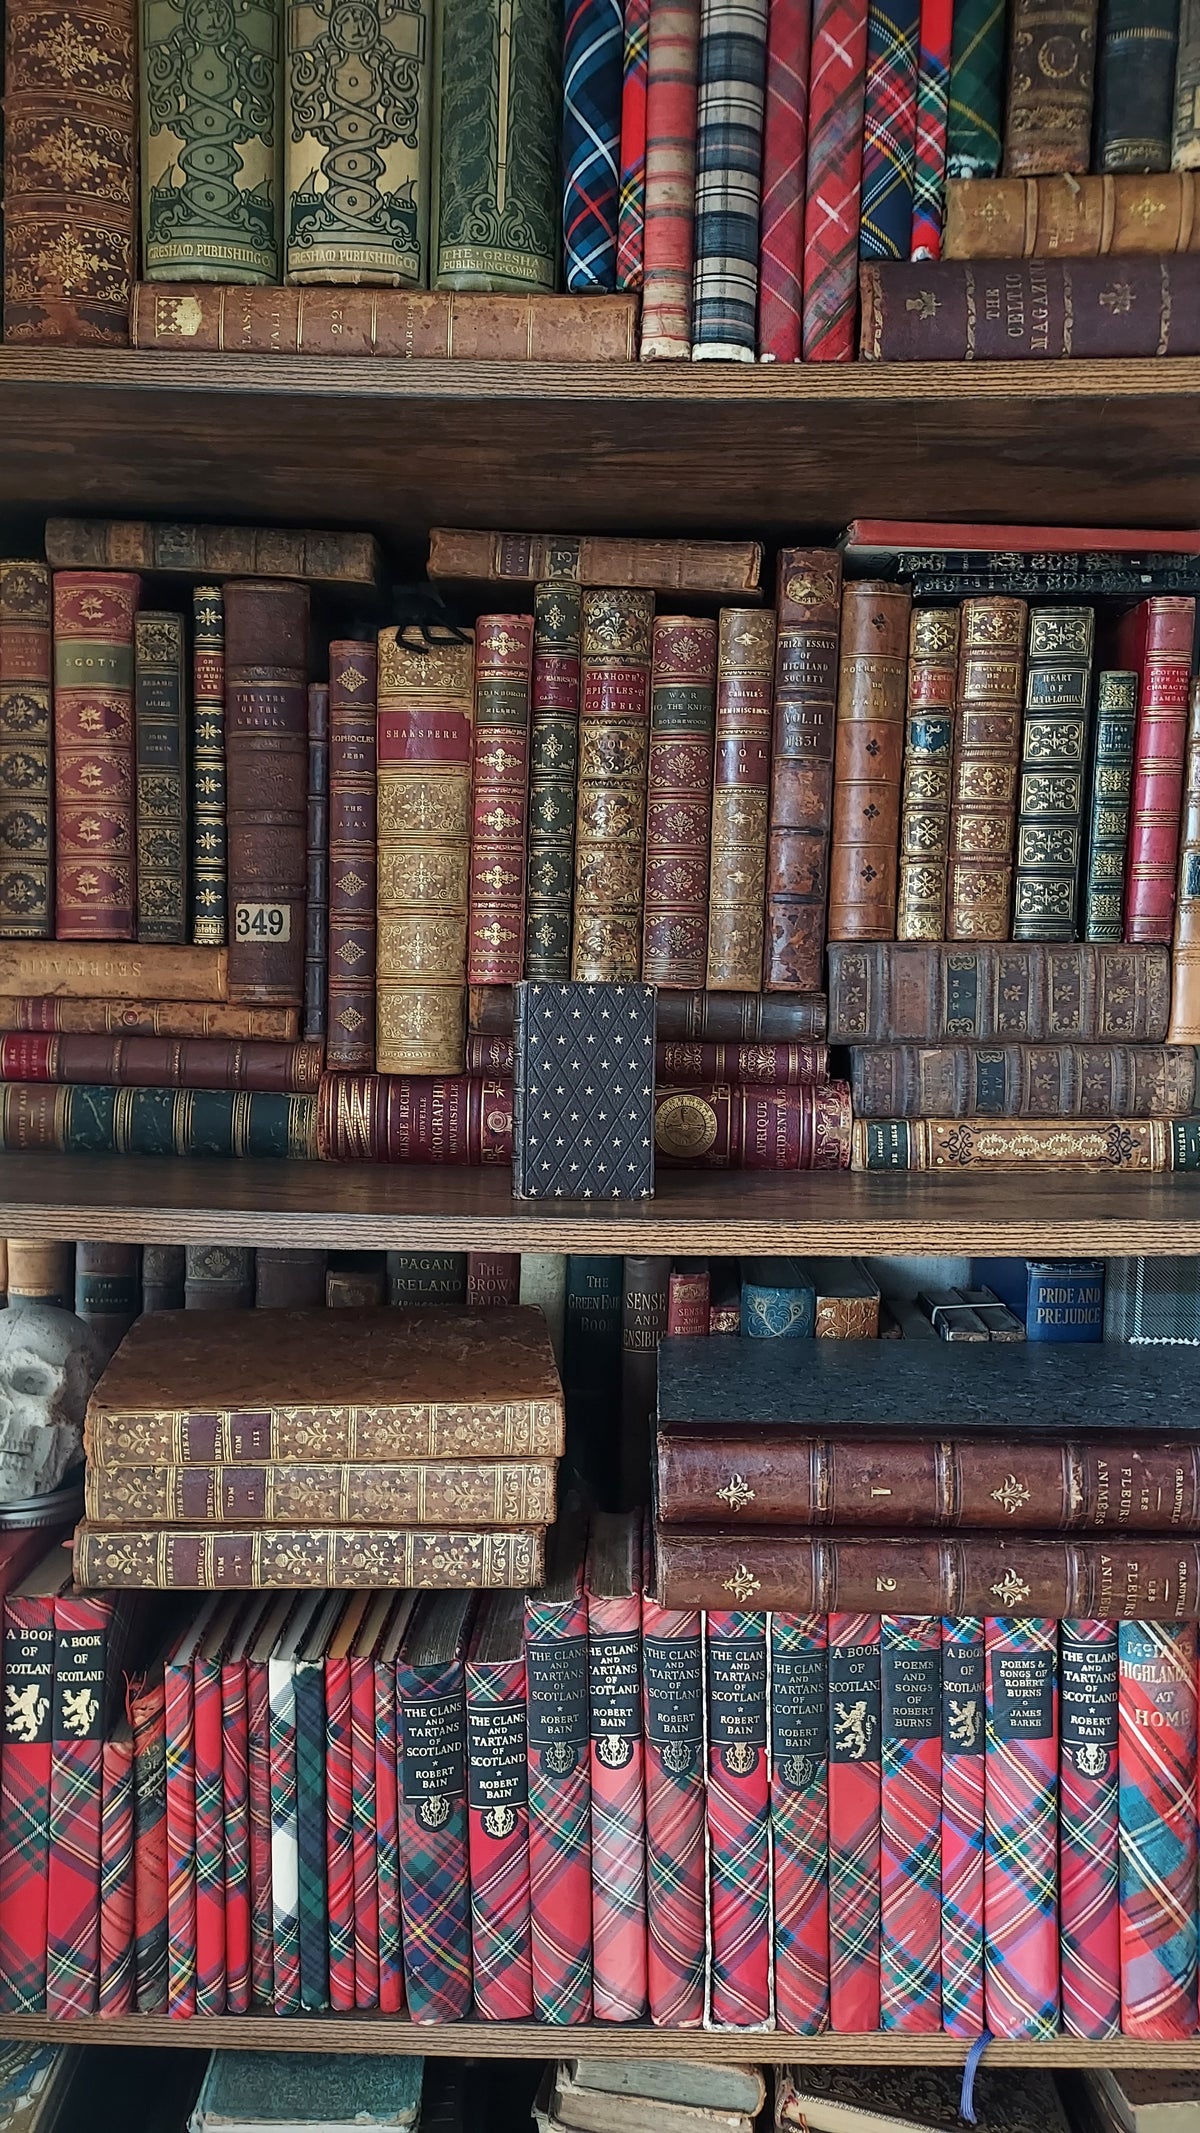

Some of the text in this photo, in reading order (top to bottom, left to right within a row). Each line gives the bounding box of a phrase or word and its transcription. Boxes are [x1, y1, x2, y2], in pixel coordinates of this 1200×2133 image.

[194, 244, 261, 264] PUBLISHING
[339, 250, 402, 265] PUBLISHING
[442, 249, 472, 260] THE
[986, 288, 1000, 320] THE
[1006, 272, 1024, 337] CELTIC
[329, 309, 344, 334] 22
[806, 640, 835, 650] ESSAYS
[66, 658, 117, 668] SCOTT
[784, 674, 824, 684] SOCIETY
[1043, 673, 1072, 683] HEART
[1050, 684, 1064, 693] OF
[585, 701, 642, 712] GOSPELS
[667, 703, 684, 711] THE
[386, 730, 458, 740] SHAKSPERE
[237, 908, 285, 936] 349
[952, 979, 960, 1011] TOM
[982, 1067, 990, 1096] TOM
[419, 1097, 427, 1144] NOUVELLE
[449, 1083, 459, 1154] UNIVERSELLE
[756, 1100, 769, 1157] AFRIQUE
[891, 1124, 899, 1164] DE LISLE
[399, 1257, 455, 1271] PAGAN
[392, 1278, 462, 1292] IRELAND
[626, 1291, 666, 1312] SENSE
[1038, 1287, 1101, 1304] PRIDE AND
[634, 1315, 659, 1326] AND
[1036, 1307, 1101, 1325] PREJUDICE
[234, 1434, 243, 1454] TOM
[227, 1485, 236, 1509] TOM
[247, 1490, 255, 1502] II
[871, 1486, 893, 1498] 1
[1119, 1467, 1132, 1524] FLEURS
[1171, 1467, 1184, 1525] GRANDVILLE
[1141, 1487, 1150, 1512] LES
[217, 1556, 226, 1579] TOM
[876, 1576, 898, 1592] 2
[1124, 1561, 1138, 1617] FLEURS
[1175, 1560, 1187, 1617] GRANDVILLE
[1147, 1579, 1157, 1602] LES
[6, 1628, 16, 1640] A
[60, 1635, 102, 1648] A BOOK
[21, 1646, 39, 1657] OF
[529, 1647, 588, 1661] THE CLANS
[604, 1643, 639, 1657] CLANS
[646, 1647, 701, 1661] THE CLANS
[711, 1650, 733, 1661] THE
[831, 1645, 880, 1659] A BOOK
[946, 1647, 955, 1659] A
[73, 1653, 89, 1665] OF
[600, 1657, 621, 1665] AND
[1062, 1650, 1118, 1664] THE CLANS
[550, 1662, 569, 1670] AND
[730, 1662, 751, 1670] AND
[849, 1663, 866, 1674] OF
[894, 1660, 934, 1670] POEMS
[960, 1665, 975, 1676] OF
[1001, 1660, 1046, 1669] POEMS &
[1080, 1664, 1103, 1673] AND
[56, 1670, 105, 1682] SCOTLAND
[533, 1669, 585, 1682] TARTANS
[650, 1668, 701, 1681] TARTANS
[713, 1671, 766, 1683] TARTANS
[789, 1676, 809, 1684] AND
[902, 1673, 926, 1682] AND
[999, 1669, 1048, 1679] SONGS OF
[1064, 1670, 1117, 1685] TARTANS
[553, 1682, 565, 1691] OF
[605, 1676, 618, 1685] OF
[669, 1681, 681, 1690] OF
[1004, 1679, 1045, 1688] ROBERT
[734, 1683, 747, 1692] OF
[772, 1683, 824, 1695] TARTANS
[894, 1683, 933, 1693] SONGS
[1006, 1689, 1043, 1698] BURNS
[1084, 1684, 1098, 1693] OF
[531, 1689, 586, 1702] SCOTLAND
[649, 1687, 702, 1701] SCOTLAND
[792, 1696, 806, 1704] OF
[907, 1695, 922, 1705] OF
[1062, 1690, 1119, 1704] SCOTLAND
[1155, 1691, 1174, 1703] AT
[405, 1702, 462, 1718] THE CLANS
[592, 1708, 633, 1718] ROBERT
[892, 1706, 936, 1716] ROBERT
[1010, 1709, 1043, 1718] JAMES
[425, 1718, 445, 1727] AND
[469, 1713, 526, 1726] THE CLANS
[540, 1714, 580, 1725] ROBERT
[600, 1718, 627, 1728] BAIN
[657, 1713, 696, 1724] ROBERT
[720, 1715, 761, 1726] ROBERT
[895, 1718, 933, 1728] BURNS
[1010, 1718, 1043, 1728] BARKE
[1070, 1714, 1113, 1726] ROBERT
[1134, 1708, 1191, 1727] HOME
[408, 1722, 460, 1738] TARTANS
[487, 1727, 508, 1736] AND
[547, 1725, 574, 1735] BAIN
[663, 1724, 689, 1734] BAIN
[727, 1726, 754, 1735] BAIN
[777, 1728, 819, 1738] ROBERT
[1078, 1726, 1106, 1737] BAIN
[428, 1739, 441, 1747] OF
[472, 1733, 524, 1747] TARTANS
[785, 1739, 811, 1748] BAIN
[406, 1742, 463, 1757] SCOTLAND
[492, 1748, 504, 1756] OF
[470, 1753, 527, 1768] SCOTLAND
[415, 1766, 455, 1780] ROBERT
[422, 1778, 448, 1789] BAIN
[479, 1777, 519, 1790] ROBERT
[486, 1789, 513, 1800] BAIN
